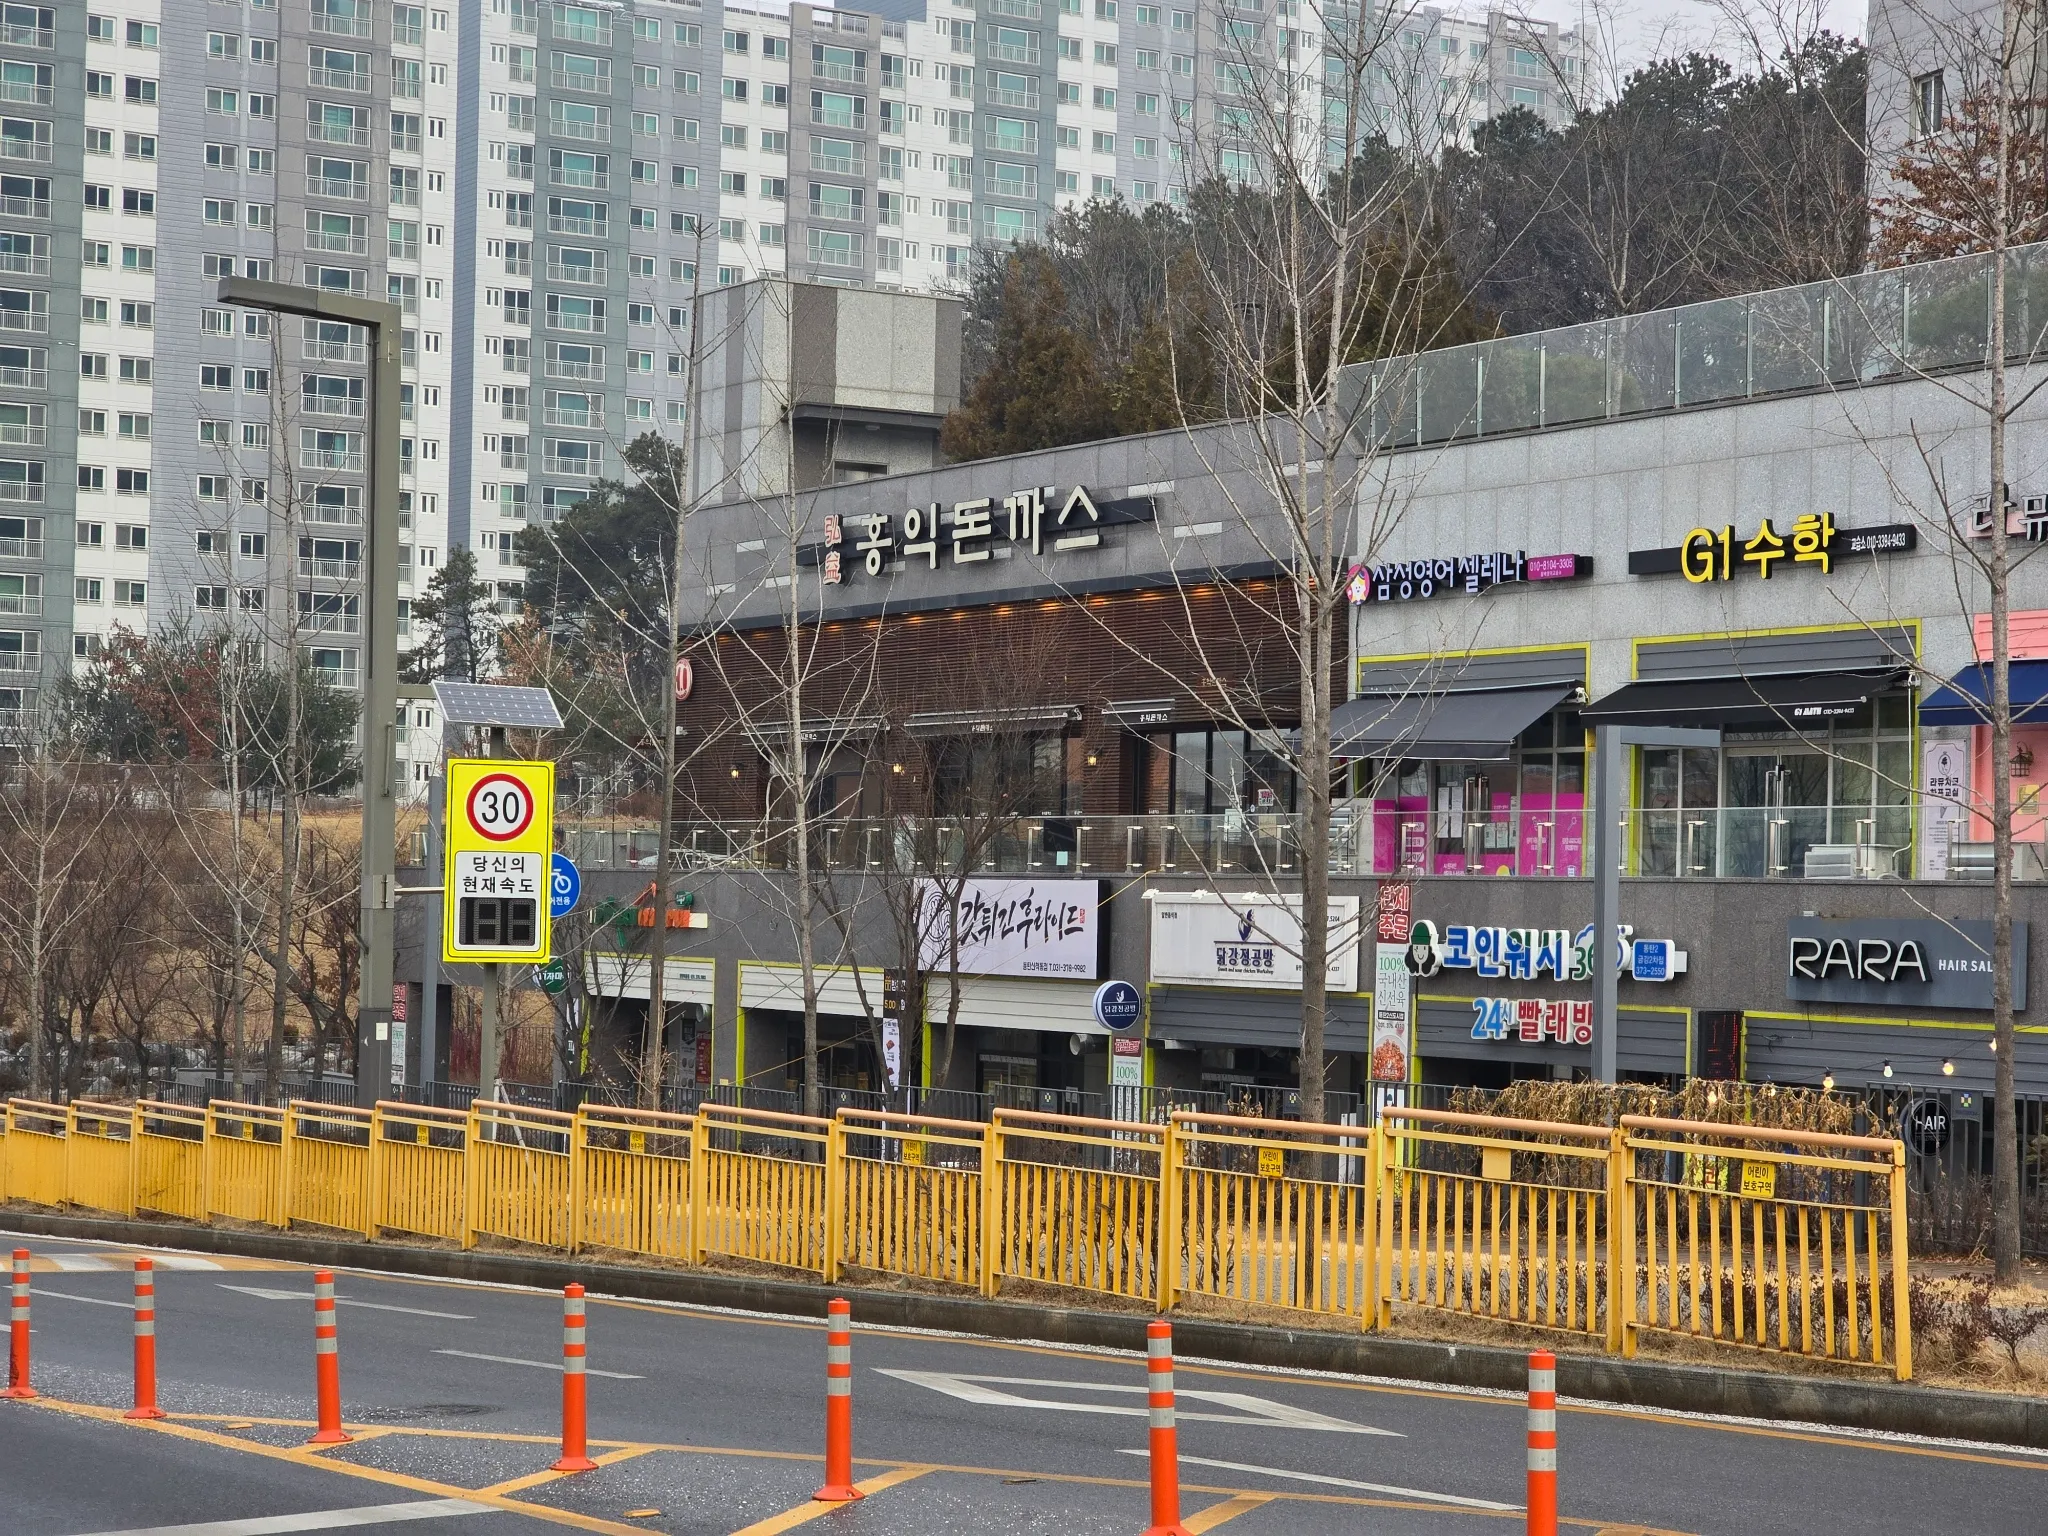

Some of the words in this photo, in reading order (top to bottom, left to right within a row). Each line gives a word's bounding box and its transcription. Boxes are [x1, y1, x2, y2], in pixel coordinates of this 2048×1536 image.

[856, 485, 1099, 577] 홍익돈까스
[1743, 512, 1835, 580] 수학
[1851, 535, 1866, 551] 교습소
[1530, 558, 1573, 571] 010-8104-3305
[1372, 557, 1455, 600] 삼성영어
[1459, 550, 1524, 593] 셀레나
[481, 791, 520, 824] 30
[473, 855, 525, 873] 당신의
[462, 876, 535, 893] 현재속도
[1379, 914, 1408, 940] 주문
[1216, 947, 1275, 967] 닭강정공방
[1443, 927, 1563, 979] 코인워시
[1643, 944, 1659, 954] 동탄2
[1379, 957, 1406, 972] 100%
[1790, 937, 1927, 983] RARA
[1938, 959, 1968, 972] HAIR
[1971, 960, 1993, 973] SAL
[1635, 966, 1665, 976] 373-2550
[1378, 972, 1407, 989] 국내산
[1378, 989, 1406, 1008] 신선육
[1472, 998, 1513, 1039] 24시
[1517, 999, 1594, 1043] 빨래방
[1115, 1066, 1138, 1079] 100%
[1262, 1150, 1279, 1162] 어린이
[1260, 1163, 1281, 1174] 보호구역
[1747, 1166, 1769, 1179] 어린이
[1743, 1180, 1772, 1193] 보호구역
